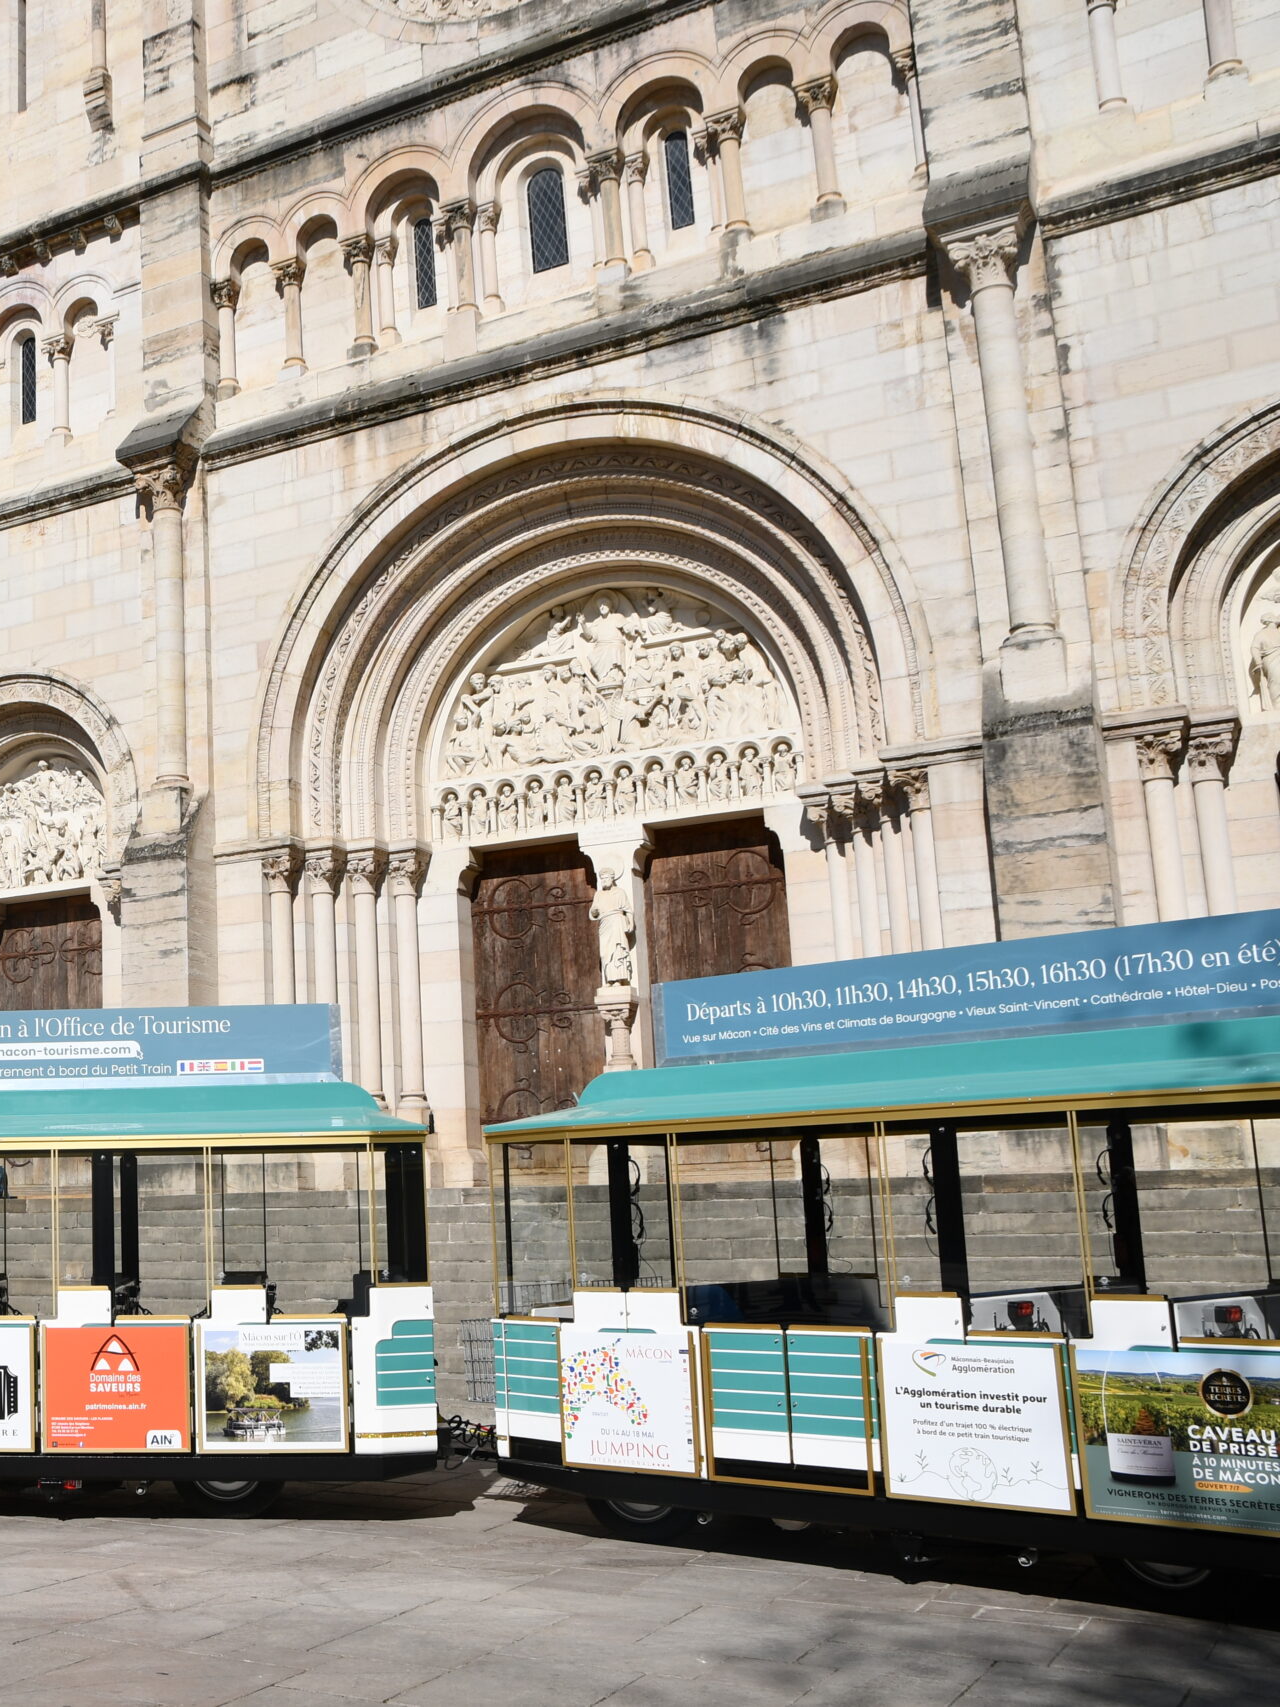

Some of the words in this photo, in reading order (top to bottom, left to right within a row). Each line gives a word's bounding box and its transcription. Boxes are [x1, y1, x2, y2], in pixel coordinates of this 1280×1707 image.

[686, 1000, 751, 1024] Départs
[756, 996, 766, 1014] à
[771, 989, 832, 1013] 10h30,
[835, 982, 893, 1007] 11h30,
[897, 974, 962, 1000] 14h30,
[966, 967, 1035, 992] 15h30,
[1040, 959, 1106, 985] 16h30
[1114, 949, 1193, 981] (17h30
[1201, 951, 1231, 968] en
[682, 1034, 701, 1044] Vue
[702, 1034, 716, 1043] sur
[719, 1030, 751, 1041] Mâcon
[759, 1025, 779, 1036] Cité
[781, 1024, 799, 1034] des
[801, 1022, 822, 1033] Vins
[824, 1021, 835, 1031] et
[836, 1016, 877, 1029] Climats
[879, 1015, 893, 1025] de
[896, 1009, 956, 1024] Bourgogne
[966, 1005, 996, 1016] Vieux
[998, 996, 1079, 1014] Saint-Vincent
[1090, 989, 1164, 1006] Cathédrale
[1174, 981, 1248, 998] Hôtel-Dieu
[17, 1019, 29, 1038] à
[35, 1016, 105, 1037] l'Office
[110, 1015, 135, 1036] de
[138, 1015, 231, 1035] Tourisme
[47, 1065, 56, 1077] à
[59, 1064, 88, 1076] bord
[93, 1064, 108, 1075] du
[111, 1063, 138, 1075] Petit
[141, 1063, 172, 1075] Train
[242, 1331, 272, 1342] Mâcon
[273, 1333, 288, 1342] sur
[625, 1345, 673, 1360] MÂCON
[950, 1356, 1014, 1365] Mâconnais-Beaujolais
[951, 1364, 1016, 1374] Agglomération
[89, 1372, 125, 1382] Domaine
[126, 1372, 142, 1382] des
[89, 1383, 141, 1393] SAVEURS
[895, 1386, 977, 1399] L'Agglomération
[979, 1390, 1019, 1402] investit
[1022, 1394, 1048, 1404] pour
[1208, 1385, 1242, 1394] TERRES
[85, 1402, 148, 1411] patrimoines.ain.fr
[920, 1401, 932, 1409] un
[934, 1401, 980, 1412] tourisme
[982, 1404, 1022, 1415] durable
[600, 1428, 611, 1436] DU
[612, 1428, 620, 1436] 14
[621, 1429, 631, 1437] AU
[641, 1431, 655, 1439] MAI
[912, 1418, 938, 1427] Profitez
[939, 1419, 954, 1428] d'un
[955, 1421, 973, 1430] trajet
[997, 1424, 1033, 1434] électrique
[150, 1434, 173, 1445] AIN
[922, 1428, 937, 1436] bord
[938, 1429, 947, 1437] de
[956, 1431, 972, 1439] petit
[974, 1432, 990, 1440] train
[991, 1433, 1030, 1443] touristique
[1187, 1424, 1276, 1445] CAVEAU
[590, 1439, 670, 1460] JUMPING
[1189, 1440, 1212, 1453] DE
[1218, 1441, 1279, 1457] PRISSÉ
[1192, 1453, 1201, 1466] À
[1203, 1457, 1217, 1467] 10
[1220, 1457, 1280, 1472] MINUTES
[1192, 1467, 1214, 1480] DE
[1219, 1468, 1280, 1485] MÂCON
[1198, 1482, 1228, 1490] OUVERT
[1107, 1487, 1165, 1501] VIGNERONS
[1167, 1493, 1188, 1503] DES
[1189, 1495, 1227, 1507] TERRES
